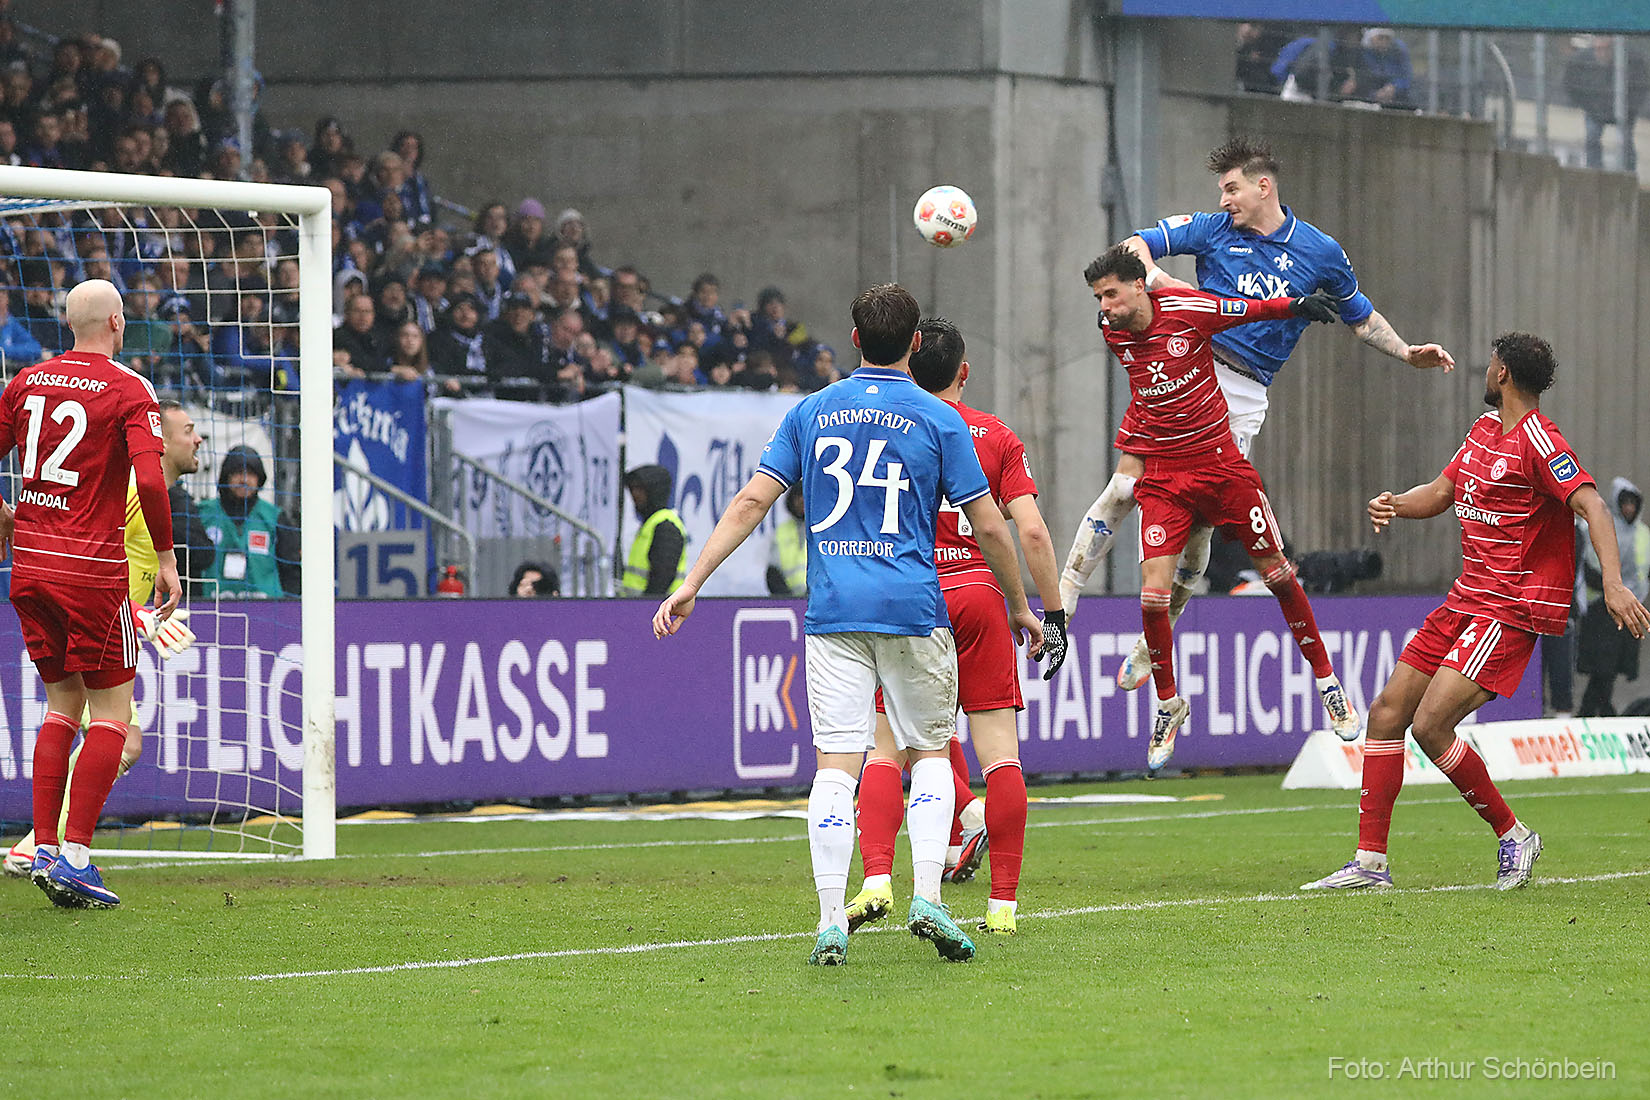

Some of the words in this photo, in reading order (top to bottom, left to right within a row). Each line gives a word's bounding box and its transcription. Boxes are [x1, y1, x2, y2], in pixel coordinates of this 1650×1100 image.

[26, 371, 109, 393] DÜSSELDORF
[817, 408, 917, 435] DARMSTADT
[23, 395, 88, 487] 12
[809, 436, 910, 535] 34
[1249, 506, 1267, 534] 8
[818, 540, 895, 559] CORREDOR
[347, 543, 419, 599] 15
[1458, 622, 1479, 649] 4
